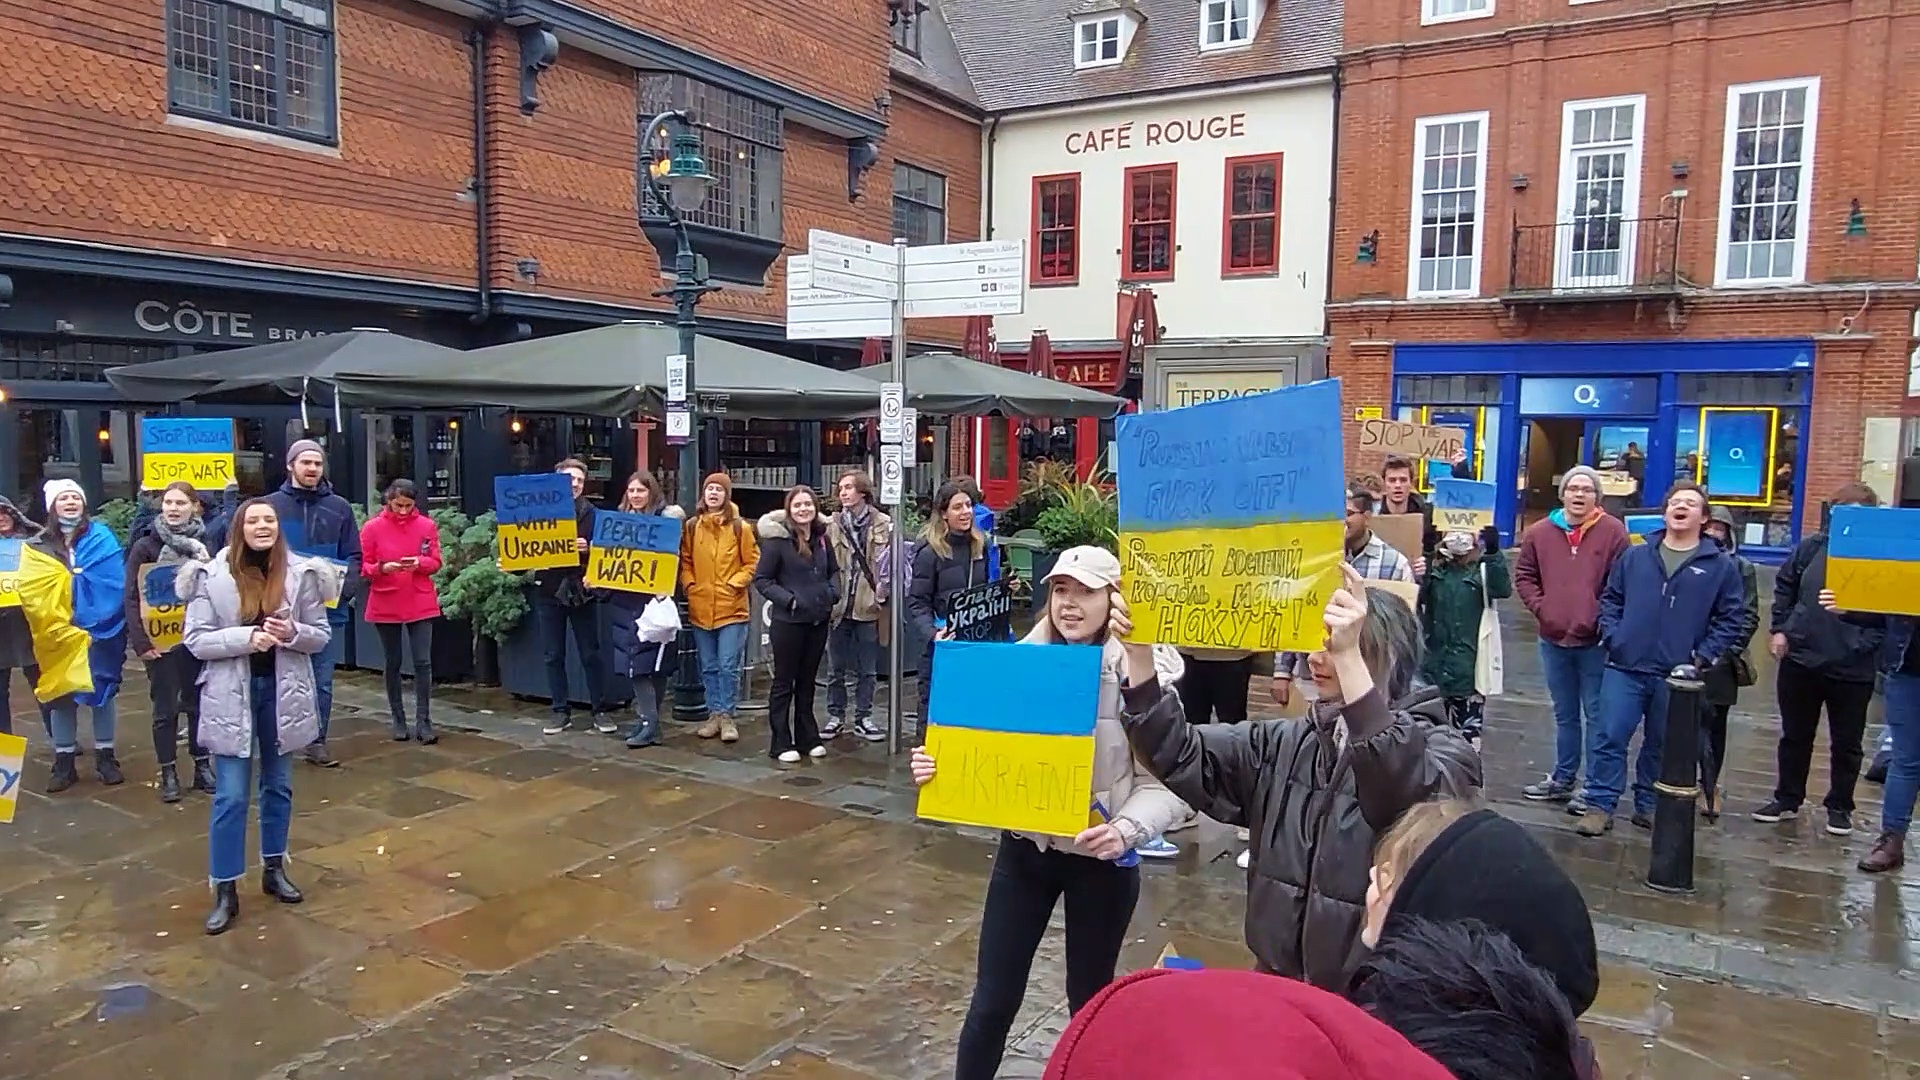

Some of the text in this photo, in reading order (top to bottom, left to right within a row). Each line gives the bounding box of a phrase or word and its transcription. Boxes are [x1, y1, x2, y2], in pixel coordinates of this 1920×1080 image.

[1065, 113, 1245, 154] CAFÉ ROUGE
[134, 300, 254, 338] CÔTE
[1054, 363, 1111, 381] CAFE
[1176, 388, 1270, 407] TERRA
[1574, 384, 1600, 408] O2
[148, 426, 183, 446] STOP
[1362, 419, 1414, 446] STOP
[150, 459, 229, 481] STOP WAR
[503, 487, 563, 510] STAND
[1446, 489, 1474, 507] NO
[514, 515, 557, 530] WITH
[1444, 511, 1478, 526] WAR
[600, 516, 662, 548] PEACE
[504, 536, 575, 560] UKRAINE
[604, 544, 633, 559] NOT
[597, 559, 658, 588] WAR!
[963, 621, 992, 640] STOP
[934, 739, 1089, 817] UKRAINE
